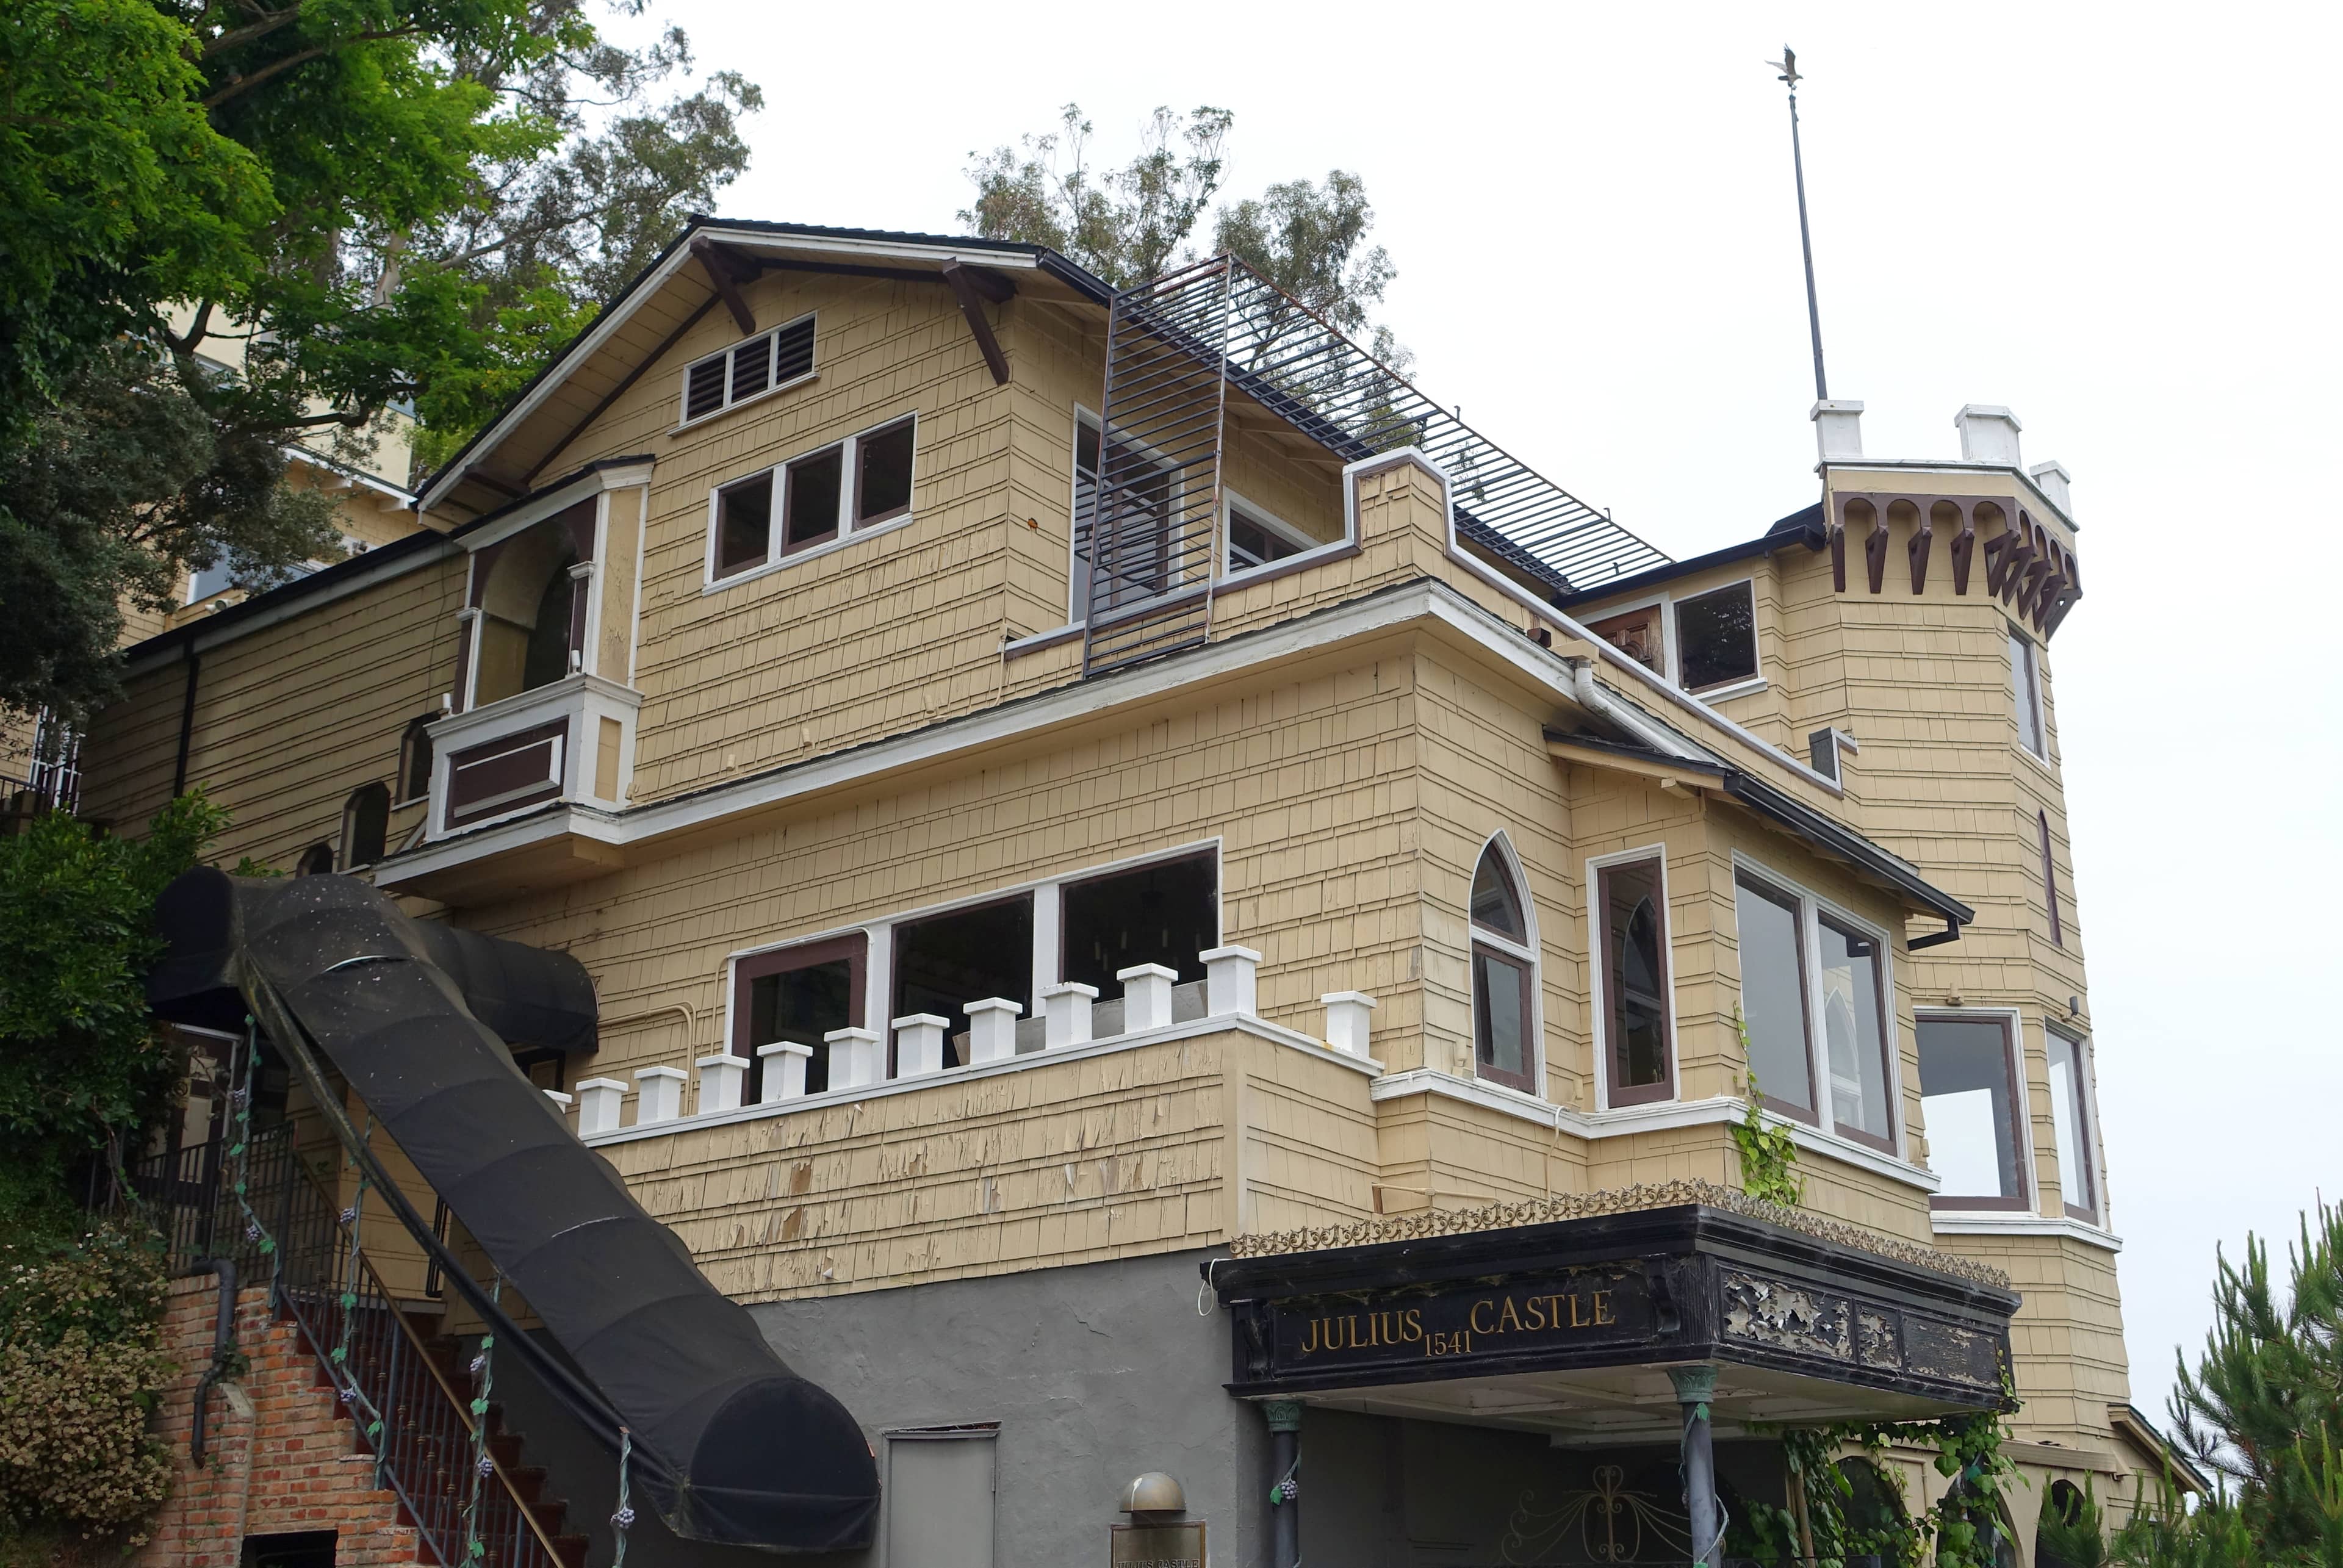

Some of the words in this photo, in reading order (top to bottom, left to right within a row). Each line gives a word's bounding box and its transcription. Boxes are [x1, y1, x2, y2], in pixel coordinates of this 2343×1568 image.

[1302, 1309, 1422, 1353] JULIUS
[1470, 1290, 1616, 1334] CASTLE
[1425, 1329, 1472, 1357] 1541
[1157, 1558, 1200, 1568] CASTLE
